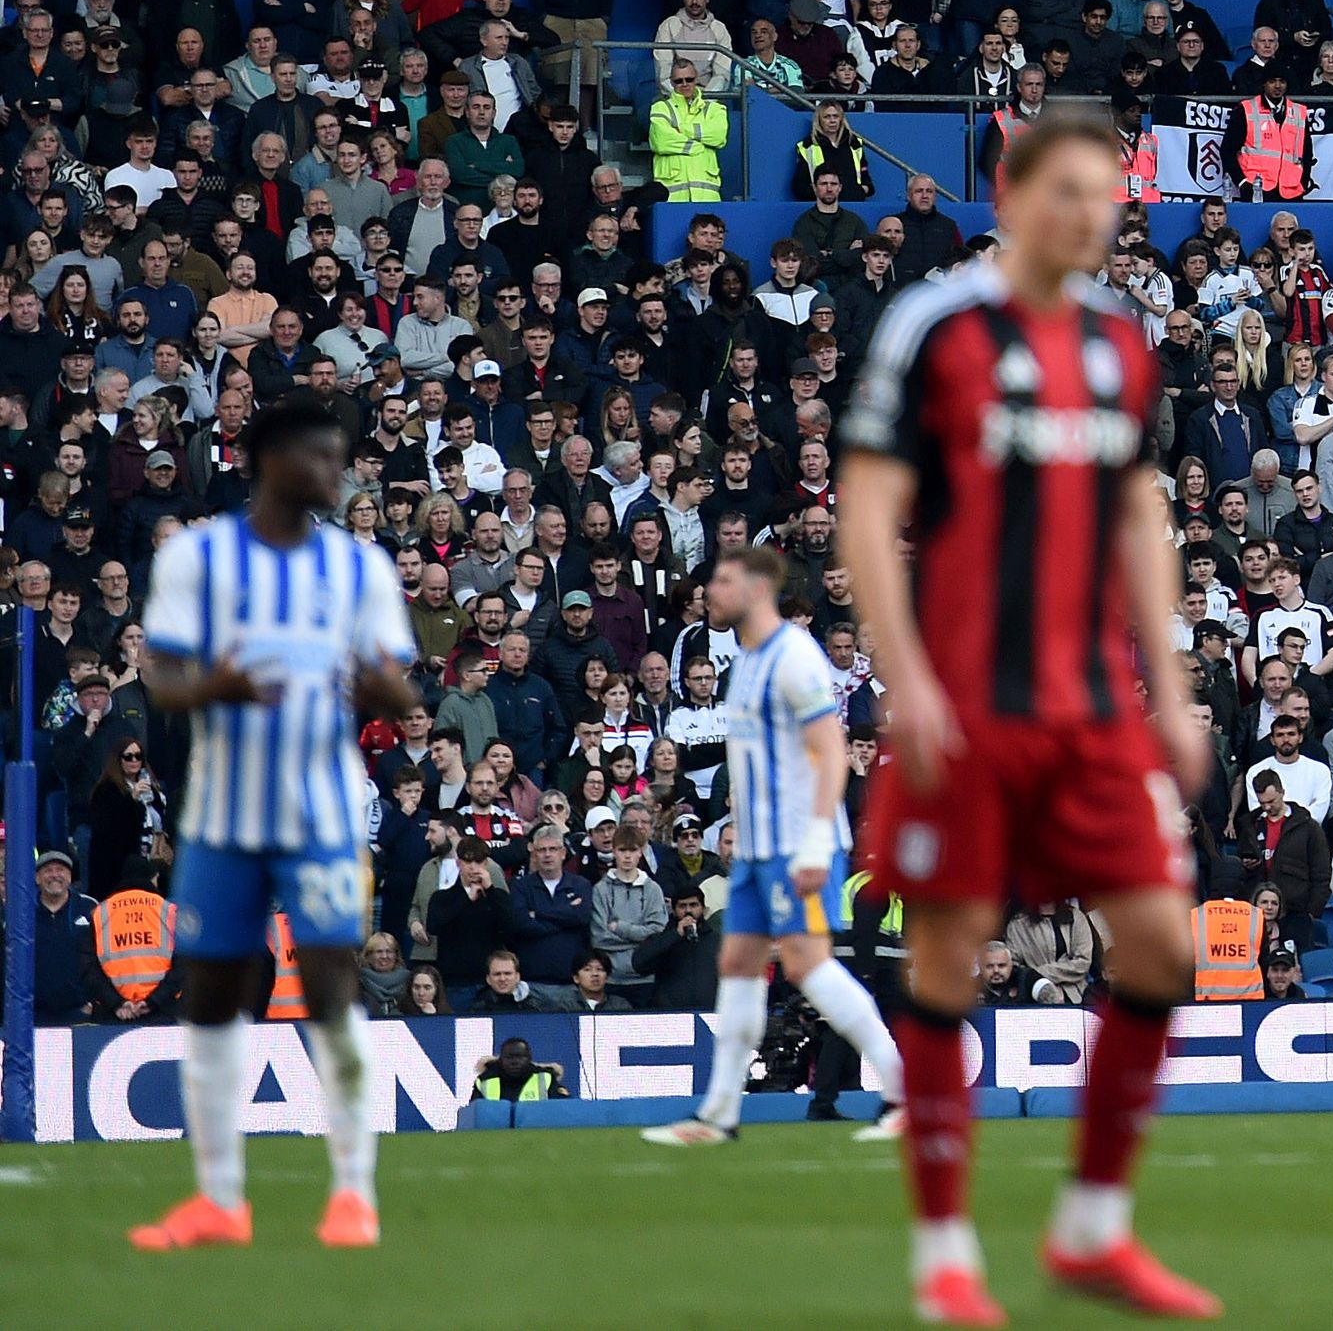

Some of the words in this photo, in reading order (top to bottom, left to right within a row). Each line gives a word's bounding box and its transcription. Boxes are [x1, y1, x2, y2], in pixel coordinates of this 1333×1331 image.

[111, 897, 158, 910] STEWARD
[1207, 906, 1251, 916] STEWARD
[114, 931, 153, 948] WISE
[1210, 943, 1247, 957] WISE
